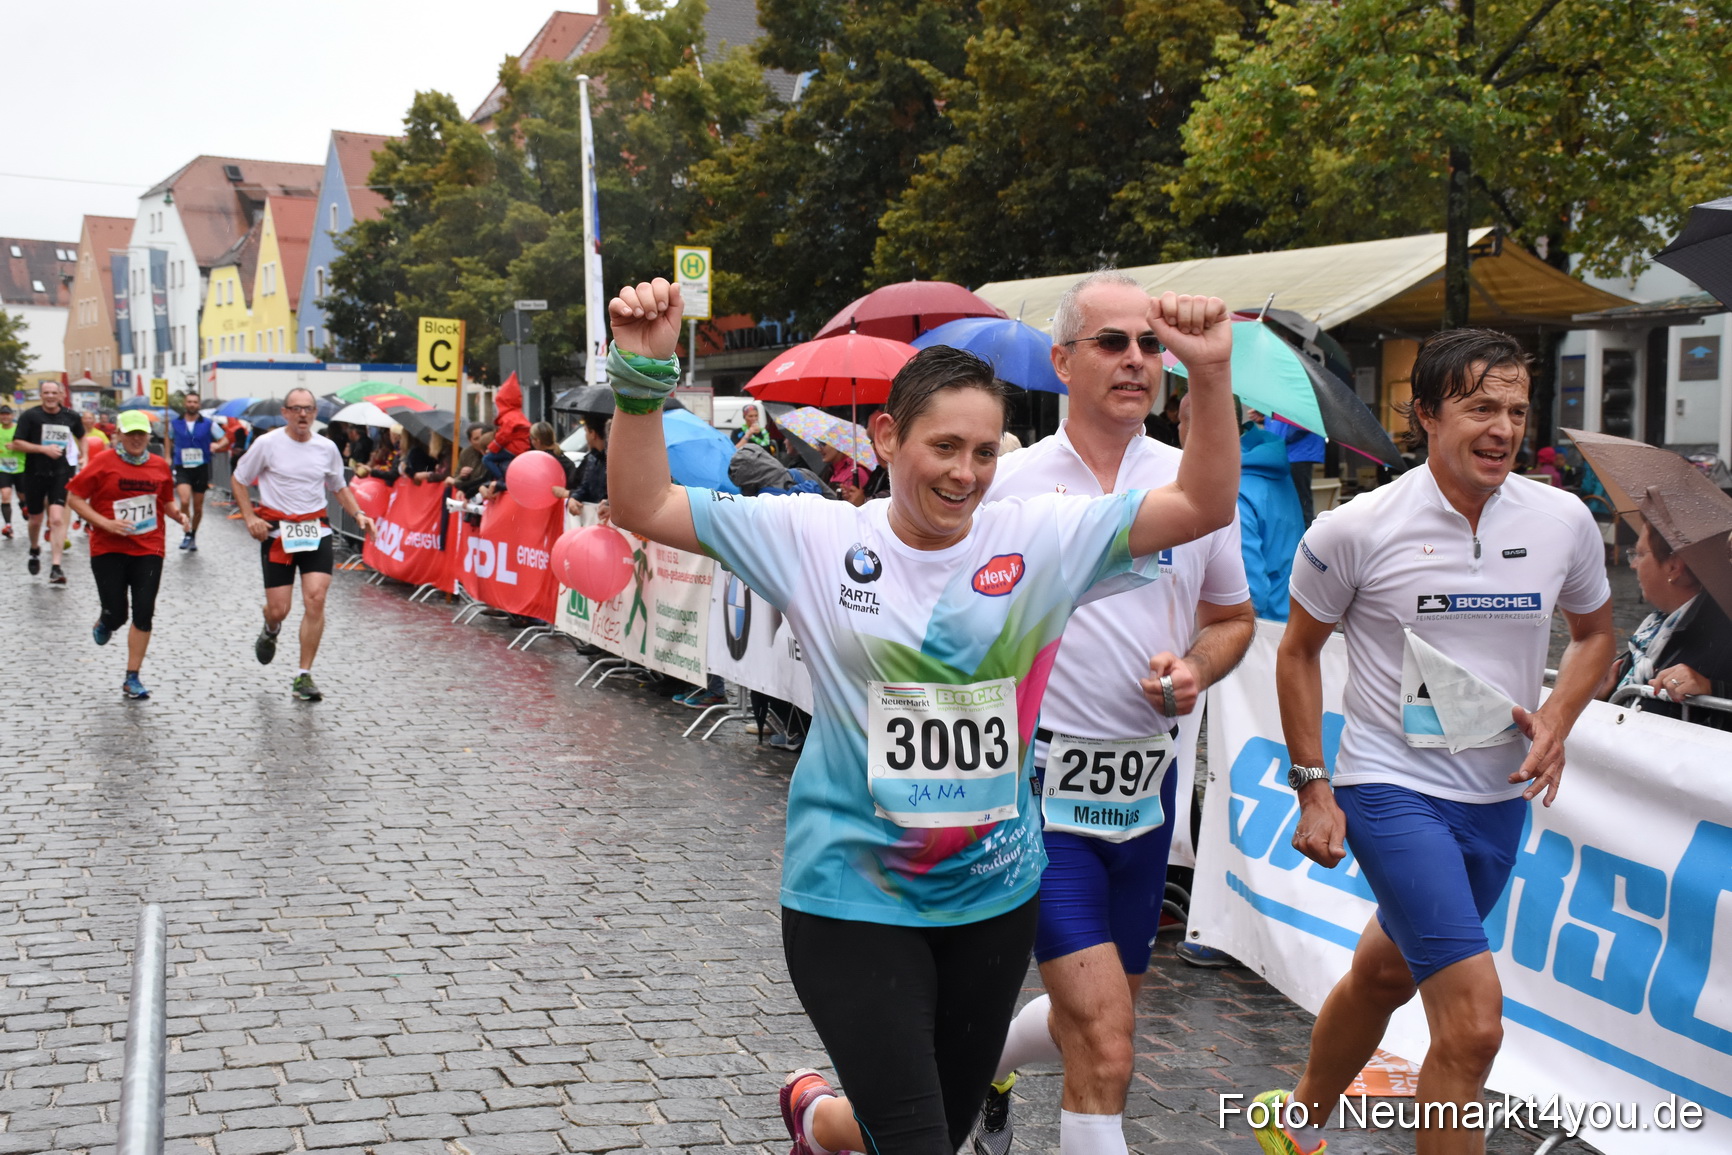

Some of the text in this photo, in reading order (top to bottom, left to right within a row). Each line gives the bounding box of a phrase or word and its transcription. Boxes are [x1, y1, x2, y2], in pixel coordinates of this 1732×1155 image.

[424, 321, 460, 335] Block
[429, 339, 452, 372] C
[154, 386, 164, 400] D
[286, 524, 319, 538] 2699
[840, 583, 880, 606] PARTL
[1456, 596, 1537, 609] BÜSCHEL
[1416, 613, 1490, 621] FEINSCHNEIDTECHNIK
[936, 685, 1004, 706] BOCK
[1406, 695, 1413, 703] D
[886, 716, 1009, 771] 3003
[1058, 749, 1165, 796] 2597
[908, 784, 966, 807] JANA
[1048, 787, 1055, 796] D
[1073, 806, 1140, 826] Matthias
